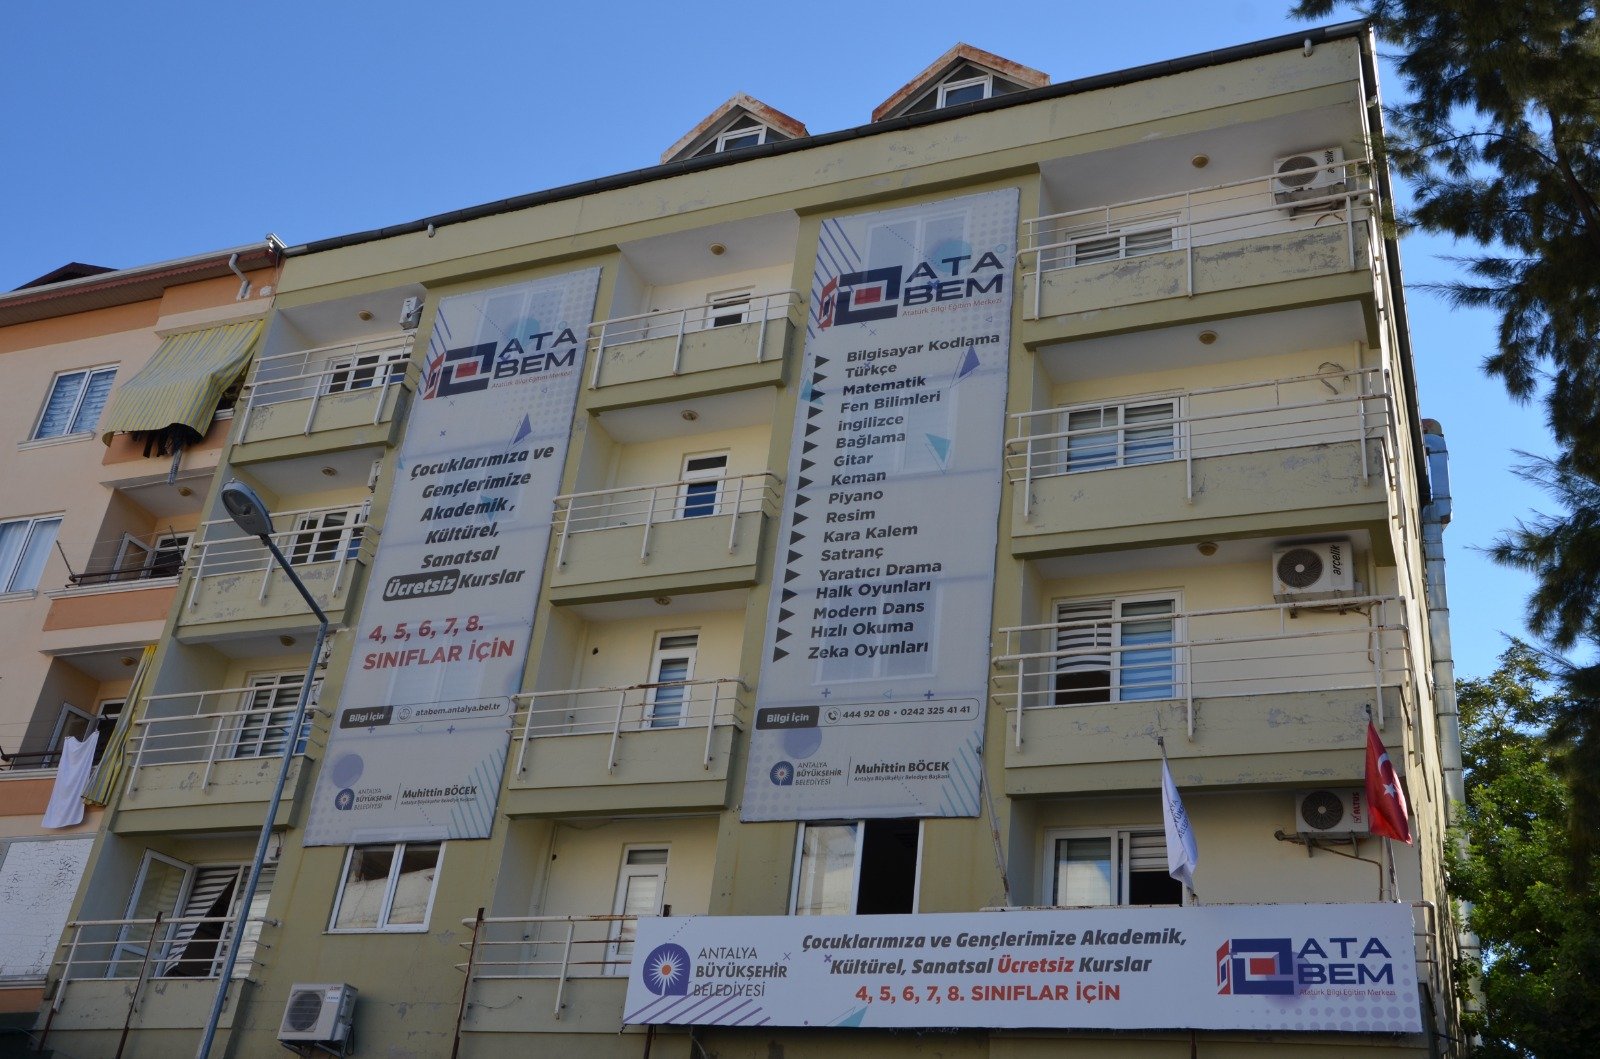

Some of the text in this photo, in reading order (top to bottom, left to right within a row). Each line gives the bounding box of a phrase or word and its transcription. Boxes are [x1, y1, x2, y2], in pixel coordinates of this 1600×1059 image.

[905, 251, 1005, 284] ATA
[903, 273, 1004, 307] BEM
[498, 327, 579, 358] ATA
[847, 333, 1000, 363] Bilgisayar Kodlama
[494, 347, 578, 380] BEM
[845, 362, 897, 379] Türkçe
[843, 375, 926, 396] Matematik
[841, 391, 942, 413] Fen Bilimleri
[836, 431, 906, 449] Bağlama
[410, 446, 555, 481] Çocuklarımıza ve
[833, 454, 874, 467] Gitar
[422, 471, 532, 499] Gençlerimize
[831, 471, 887, 486] Keman
[828, 490, 884, 505] Piyano
[826, 509, 876, 524] Resim
[425, 522, 500, 545] Kültürel,
[823, 524, 918, 543] Kara Kalem
[421, 546, 500, 569] Sanatsal
[821, 546, 885, 562] Satranç
[1330, 544, 1342, 575] arçelik
[819, 560, 942, 582] Yaratıcı Drama
[385, 569, 525, 598] Ücretsiz Kurslar
[816, 580, 931, 599] Halk Oyunları
[813, 601, 925, 619] Modern Dans
[368, 615, 484, 644] 4, 5, 6, 7, 8.
[811, 621, 914, 639] Hızlı Okuma
[363, 637, 515, 670] SINIFLAR İÇİN
[808, 640, 929, 659] Zeka Oyunları
[349, 712, 367, 724] Bilgi
[415, 702, 501, 718] atabem.antalya.bel.tr
[767, 705, 970, 725] Bilgi İçin 444 92 08 0242 325 41 41
[797, 761, 828, 769] ANTALYA
[855, 759, 949, 774] Muhittin BÖCEK
[402, 784, 478, 799] Muhittin BÖCEK
[795, 777, 831, 786] BELEDİYESİ
[1351, 792, 1361, 815] ALTUS
[802, 927, 1187, 953] Çocuklarımıza ve Gençlerimize Akademik,
[1297, 937, 1392, 959] ATA
[697, 947, 758, 960] ANTALYA
[695, 962, 788, 981] BÜYÜKŞEHİR
[830, 955, 1153, 977] Kültürel, Sanatsal Ücretsiz Kurslar
[1297, 963, 1394, 985] BEM
[693, 981, 766, 998] BELEDİYESİ
[855, 980, 1121, 1004] 4, 5, 6, 7, 8. SINIFLAR İÇİN
[1299, 988, 1324, 996] Atatürk
[1326, 987, 1341, 997] Bilgi
